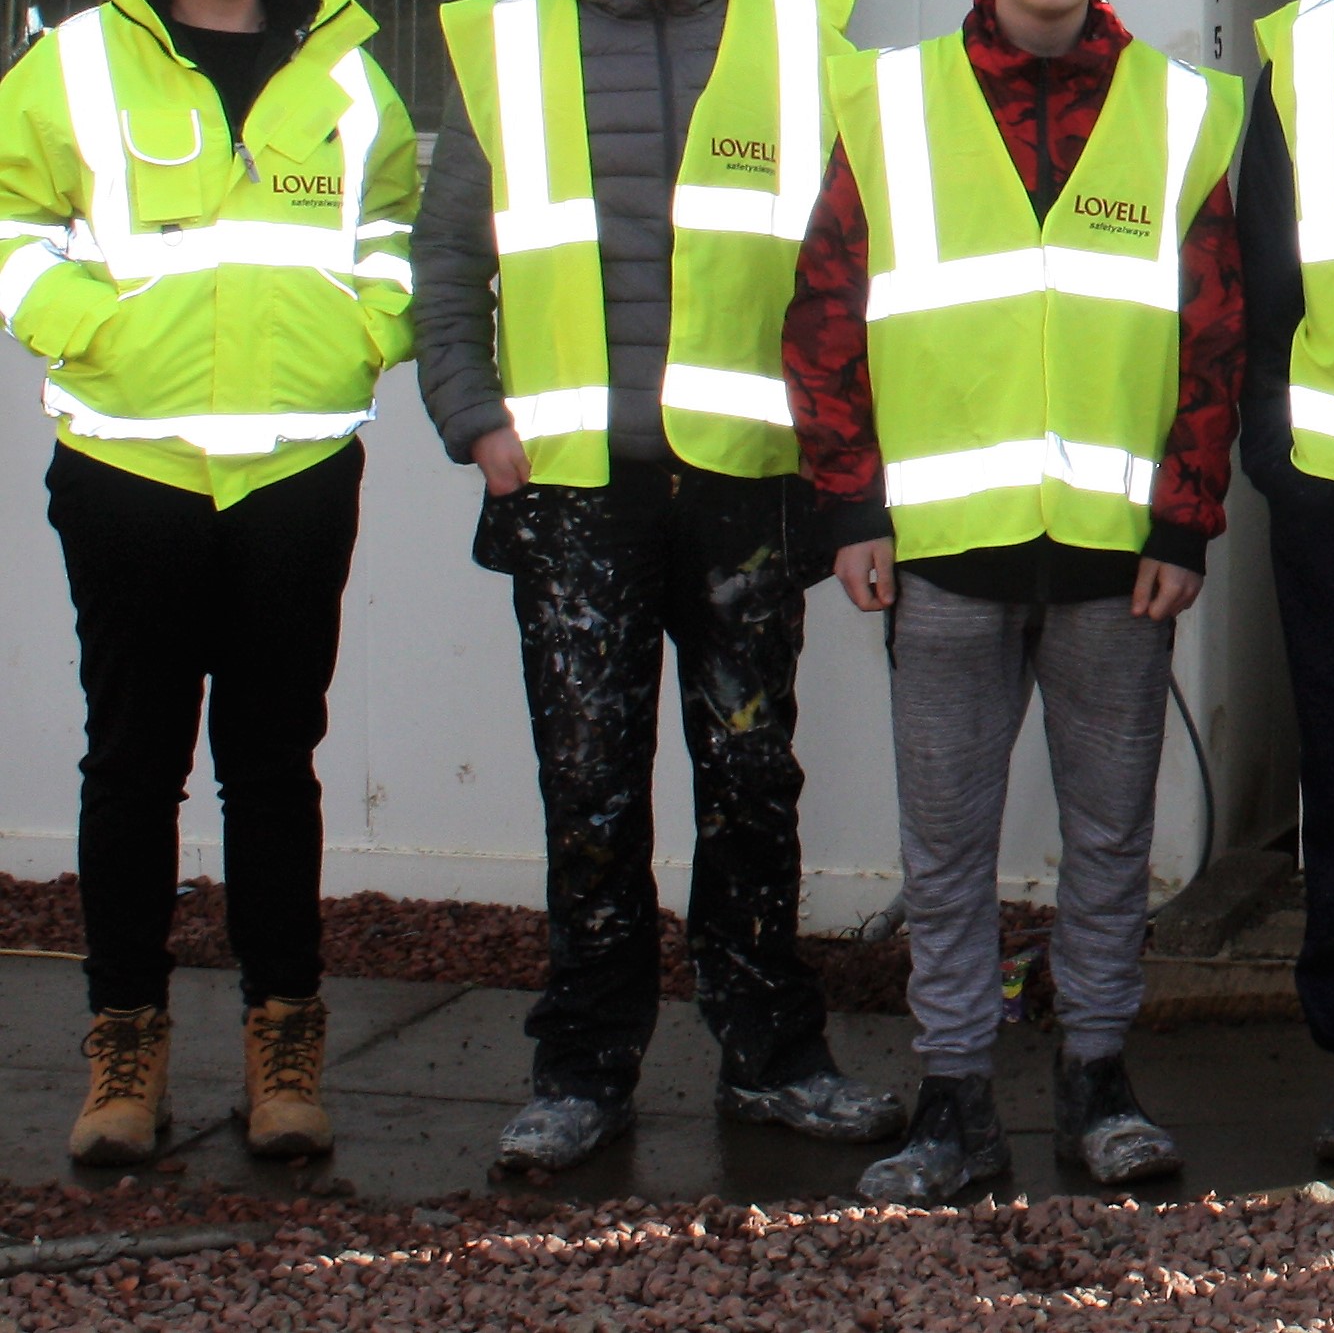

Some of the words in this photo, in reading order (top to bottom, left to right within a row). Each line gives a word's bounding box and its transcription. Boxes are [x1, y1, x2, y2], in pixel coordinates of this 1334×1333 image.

[711, 138, 777, 163] LOVELL
[272, 175, 345, 195] LOVELL
[1074, 194, 1152, 225] LOVELL
[1089, 221, 1151, 238] safetyalways
